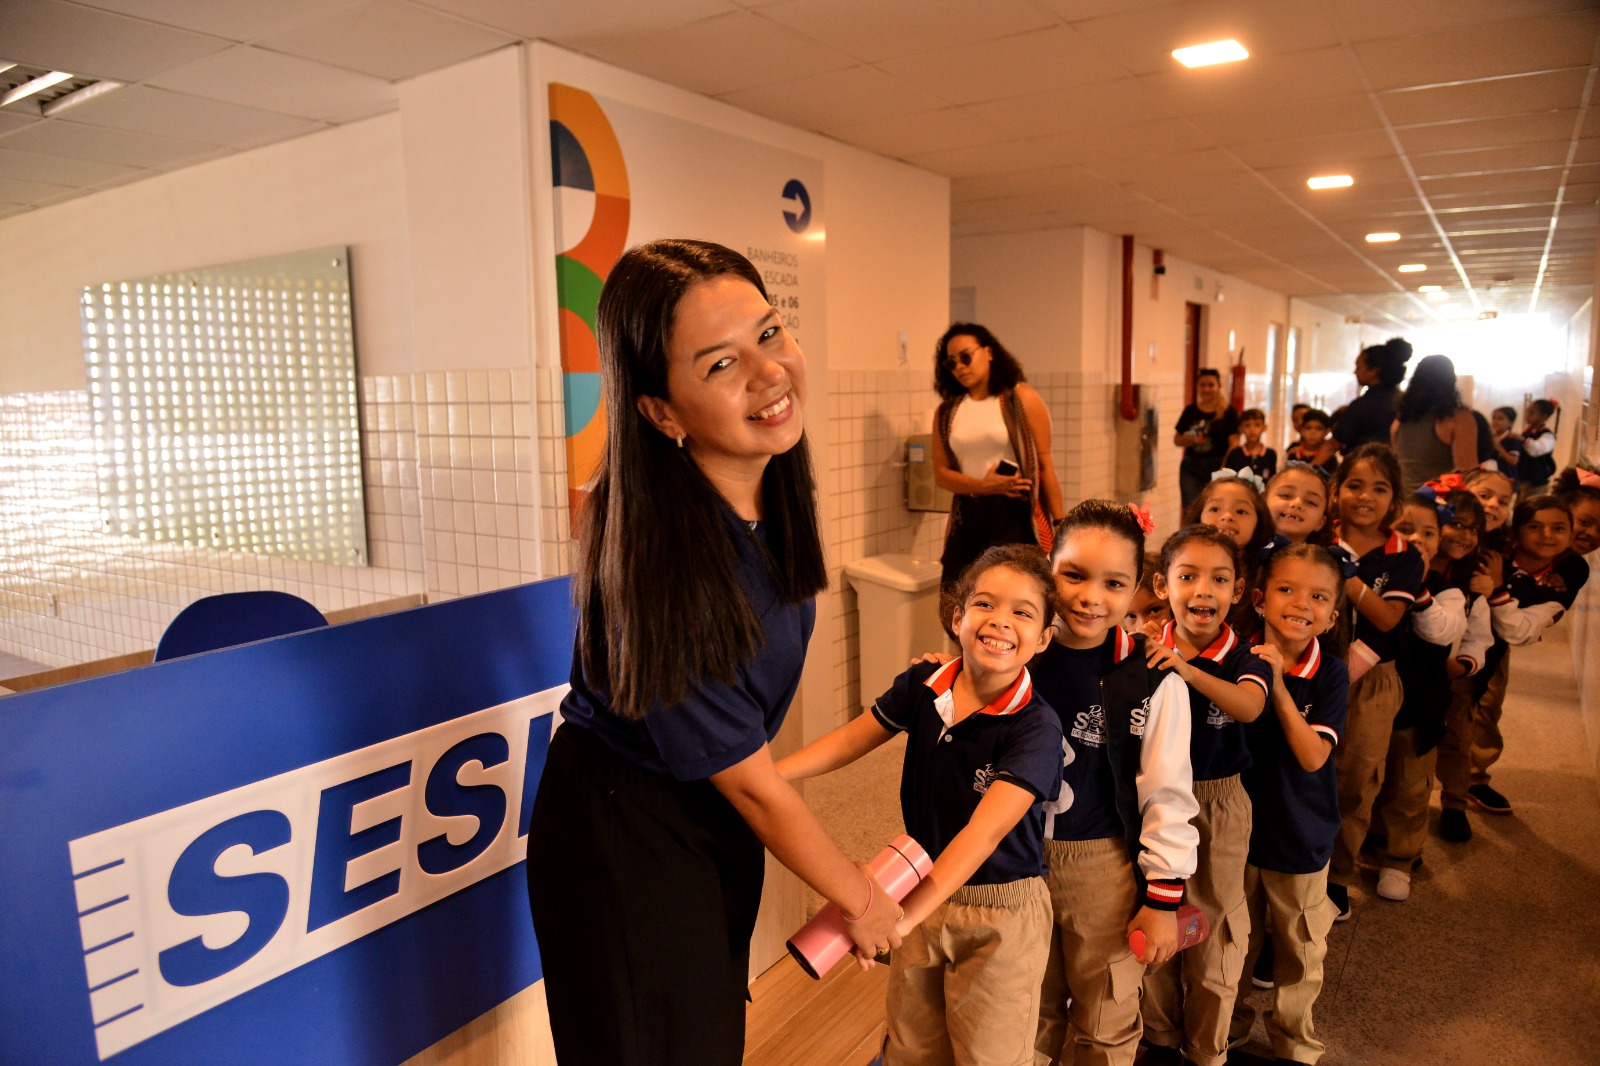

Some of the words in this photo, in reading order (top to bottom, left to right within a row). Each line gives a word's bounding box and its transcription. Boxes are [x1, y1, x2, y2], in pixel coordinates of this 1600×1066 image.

[747, 247, 798, 268] BANHEIROS
[765, 270, 799, 287] ESCADA
[767, 293, 778, 307] 05
[781, 298, 786, 308] e
[788, 296, 799, 309] 06
[158, 710, 554, 987] SESI
